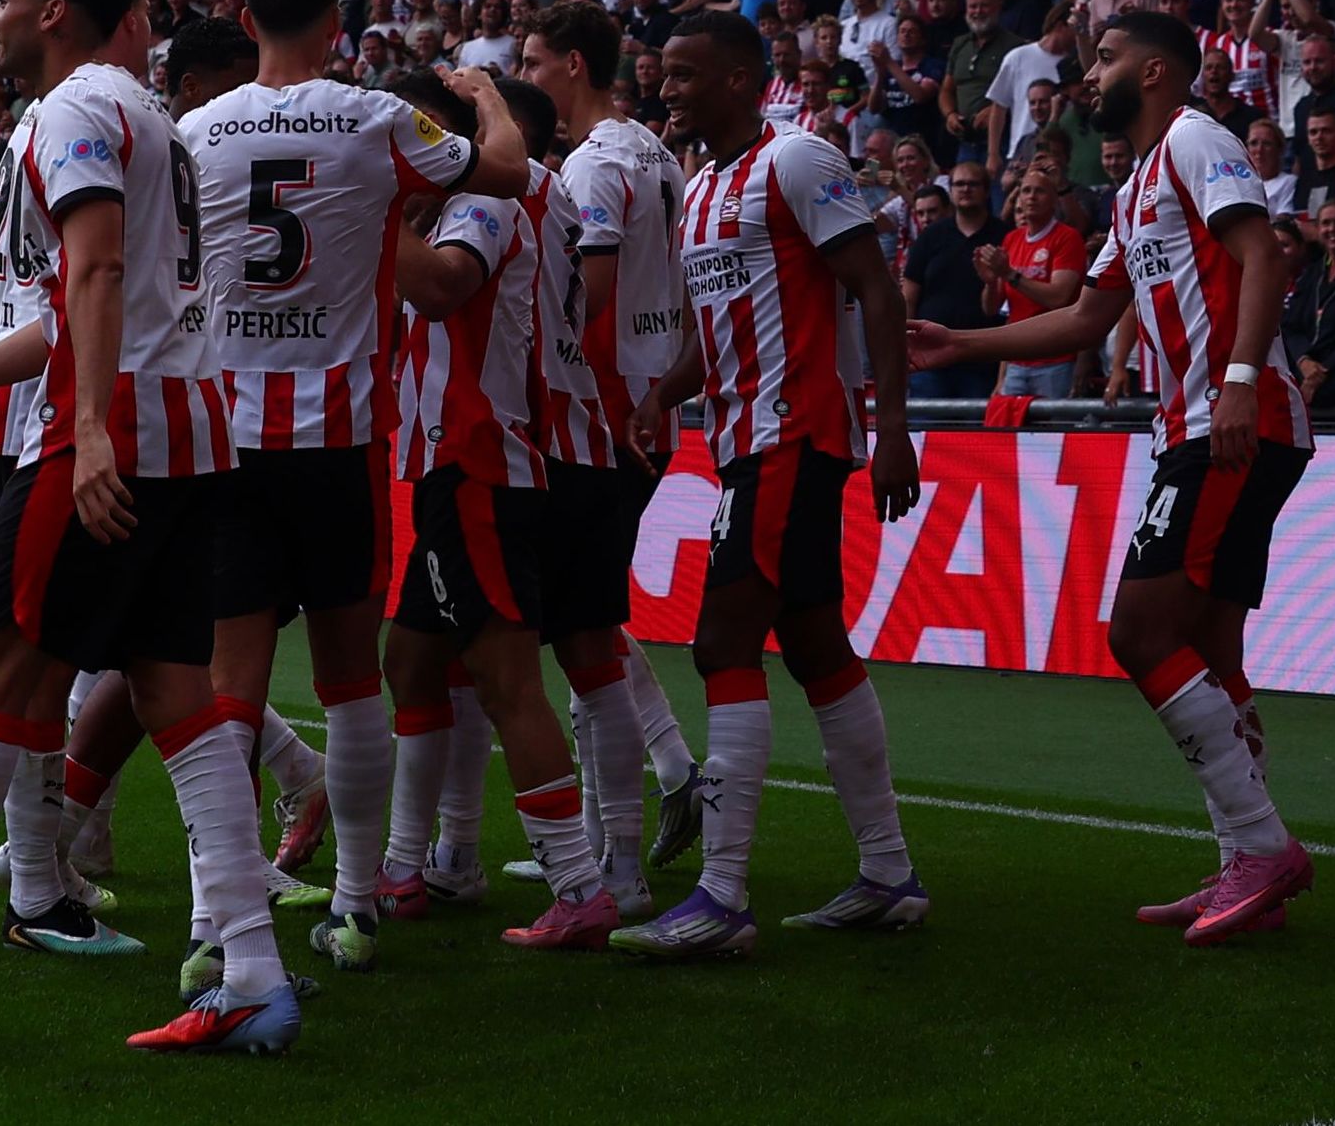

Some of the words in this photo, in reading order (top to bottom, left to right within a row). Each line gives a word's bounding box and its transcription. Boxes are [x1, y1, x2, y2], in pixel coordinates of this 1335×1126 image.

[207, 112, 359, 146] goodhabitz
[169, 140, 202, 292] 9
[244, 159, 314, 291] 5
[226, 306, 328, 339] PERIŠIĆ
[633, 312, 667, 337] VAN
[428, 549, 447, 604] 8
